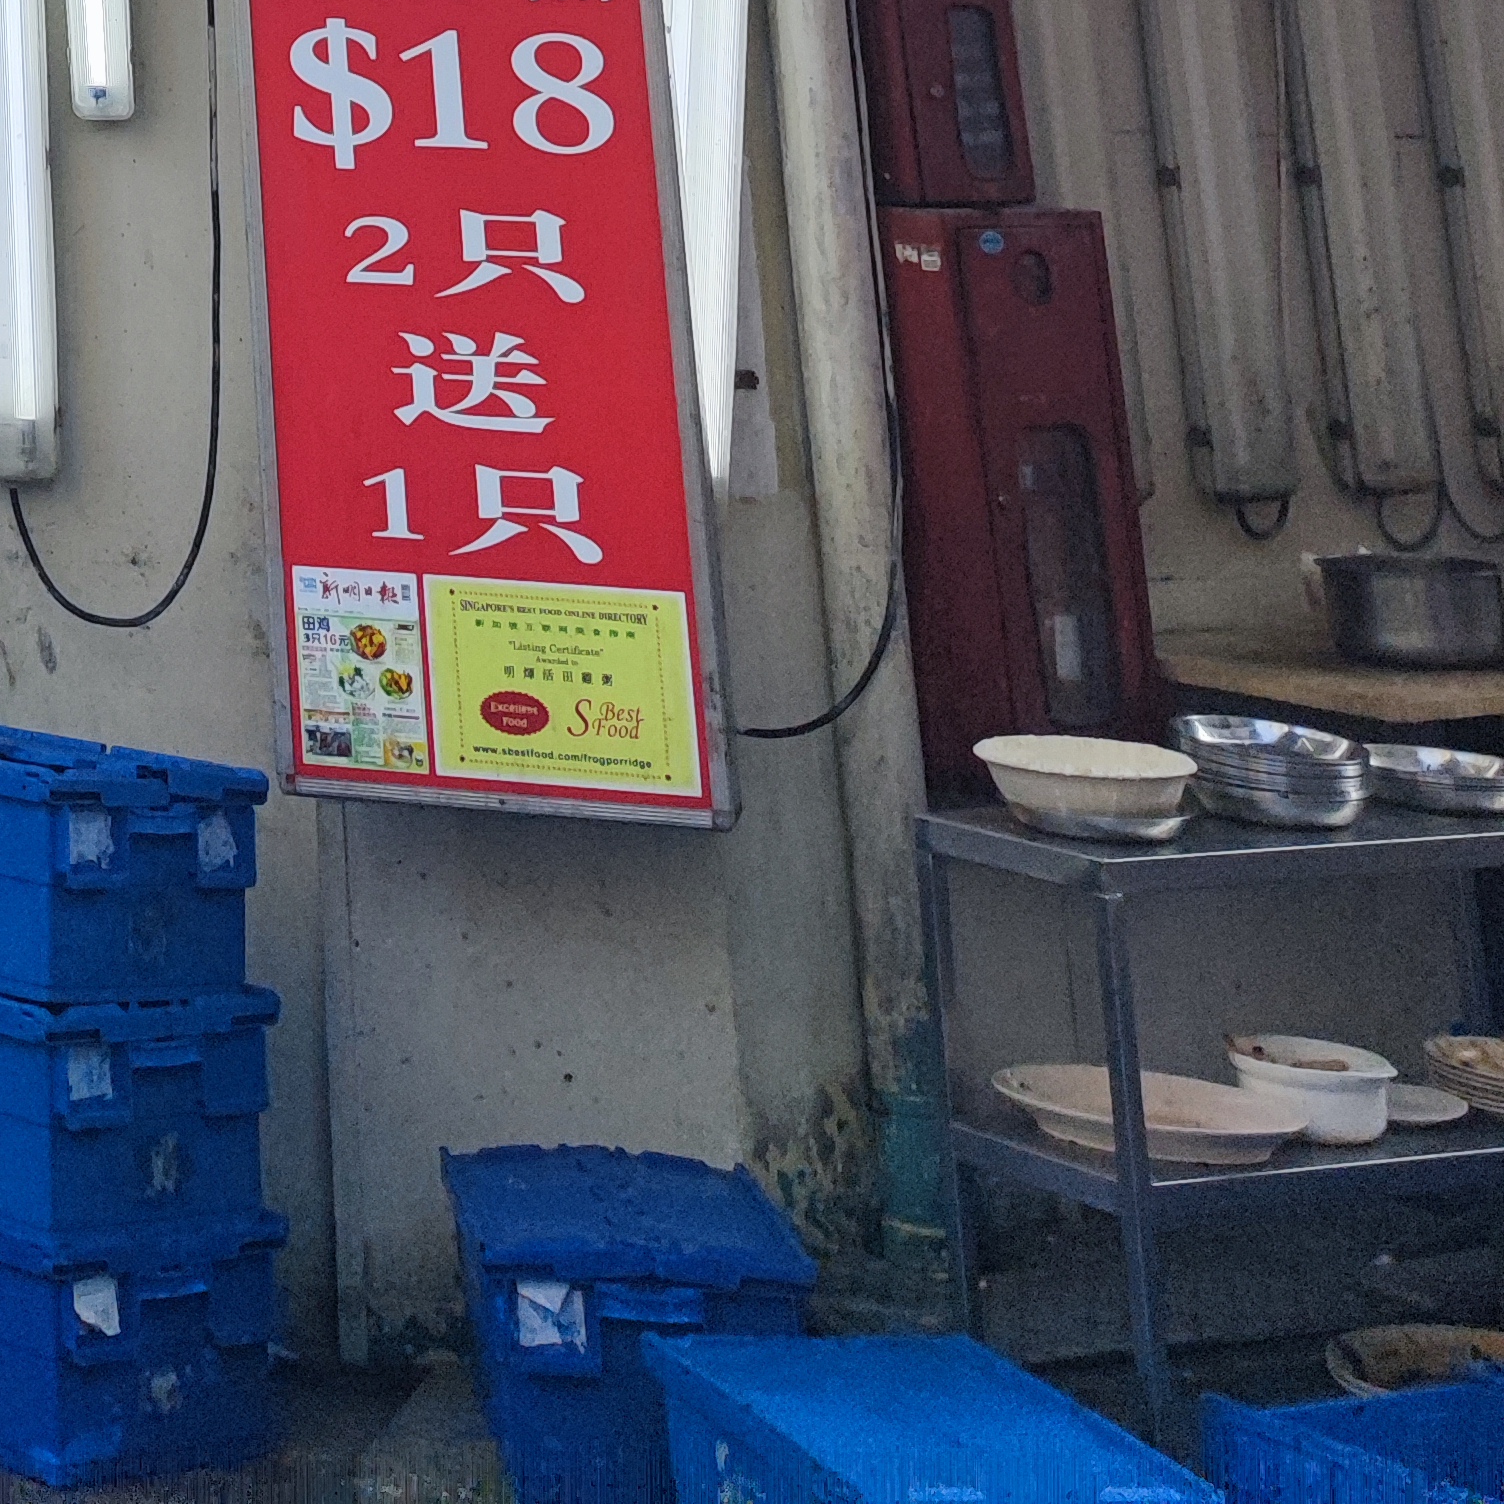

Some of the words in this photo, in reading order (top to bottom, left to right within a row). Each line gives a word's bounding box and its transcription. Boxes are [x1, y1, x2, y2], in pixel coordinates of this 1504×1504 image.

[289, 16, 615, 171] $18
[392, 331, 554, 434] 送
[301, 615, 331, 633] 田鸡
[459, 598, 515, 614] SINGAPORE'S
[539, 607, 562, 617] FOOD
[598, 611, 648, 626] DIRECTORY
[501, 715, 529, 729] Food
[599, 701, 645, 723] Best
[592, 717, 642, 740] Food
[472, 744, 653, 770] www.sbestfood.com/frogporridge
